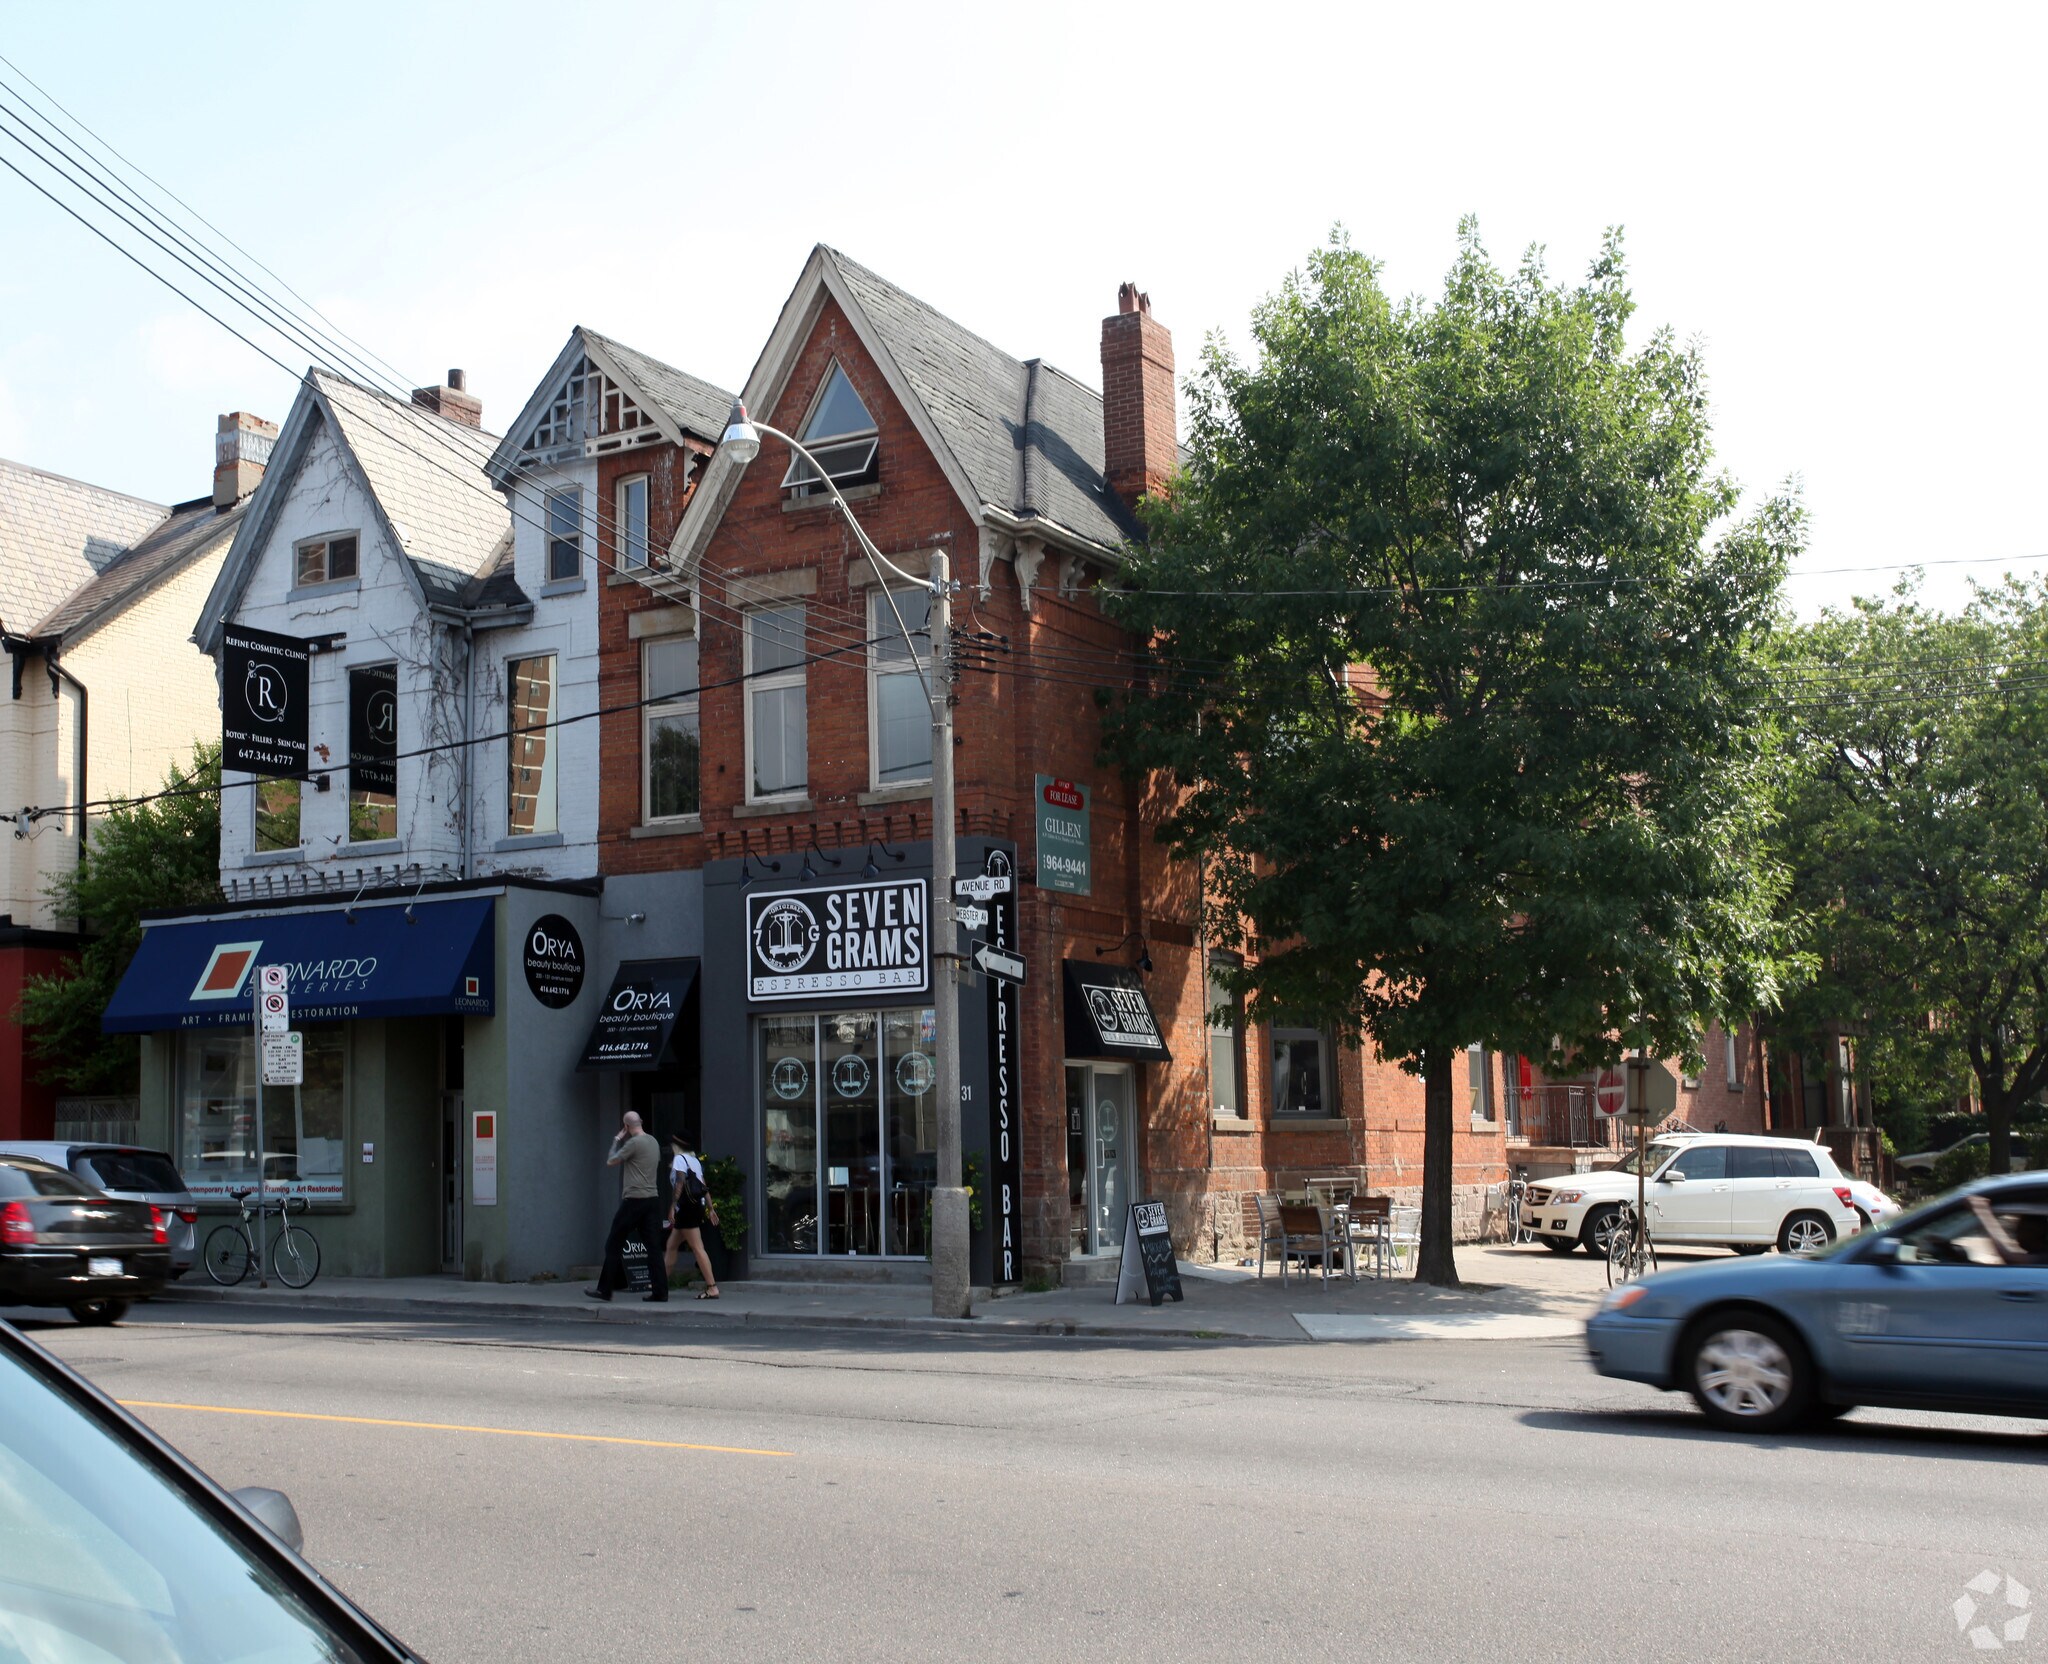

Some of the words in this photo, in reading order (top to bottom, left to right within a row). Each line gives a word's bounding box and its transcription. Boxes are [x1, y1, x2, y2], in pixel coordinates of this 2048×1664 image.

[225, 636, 250, 649] REFINE
[250, 641, 284, 656] COSMETIC
[284, 648, 308, 660] CLINIC
[258, 675, 278, 709] R
[252, 733, 273, 745] FILLERS
[277, 738, 291, 749] SKIN
[291, 740, 306, 751] CARE
[238, 748, 294, 766] 647.344.4777
[1049, 789, 1061, 802] FOR
[1061, 792, 1078, 806] LEASE
[1044, 817, 1082, 839] GILLEN
[1046, 854, 1086, 877] 964-9441
[961, 879, 990, 892] AVENUE
[826, 887, 921, 932] SEVEN
[532, 926, 576, 960] ÖRYA
[753, 929, 763, 946] 7
[807, 924, 821, 942] G
[826, 926, 921, 970] GRAMS
[527, 957, 552, 971] beauty
[552, 961, 581, 973] boutique
[243, 978, 370, 998] GLERIES
[756, 974, 862, 992] ESPRESSO
[878, 970, 917, 984] BAR
[454, 997, 490, 1008] LEONARDO
[613, 985, 671, 1011] ÖRYA
[1110, 990, 1149, 1014] SEVEN
[181, 1015, 201, 1026] ART
[291, 1006, 358, 1019] ESTORATION
[599, 1013, 632, 1024] beauty
[633, 1011, 675, 1022] boutique
[1118, 1011, 1155, 1035] GRAMS
[598, 1042, 649, 1052] 416.642.1716
[187, 1186, 224, 1194] ontemporary
[240, 1185, 258, 1193] Custo
[264, 1185, 290, 1194] Framing
[296, 1185, 306, 1193] Art
[307, 1185, 343, 1193] Restoration
[1147, 1204, 1164, 1216] SEVEN
[1001, 1183, 1014, 1281] BAR
